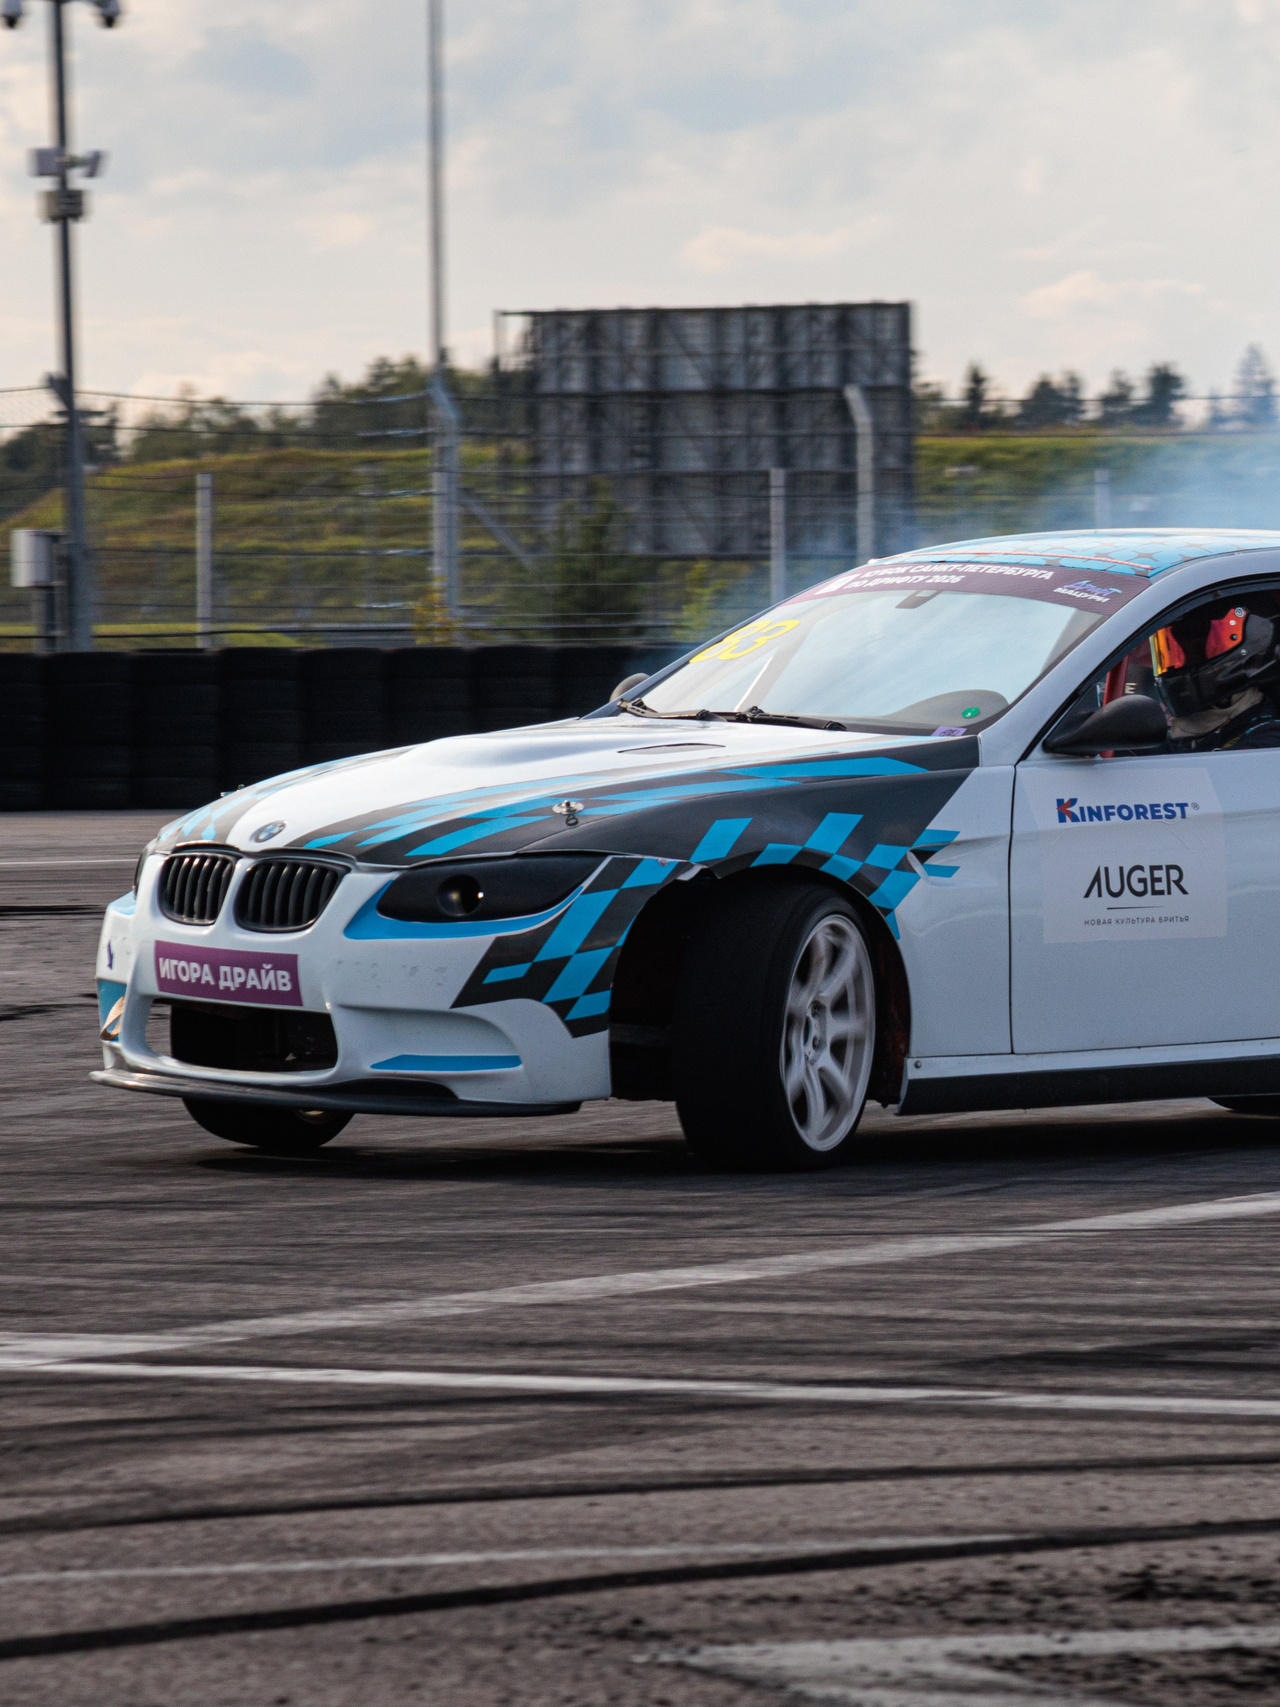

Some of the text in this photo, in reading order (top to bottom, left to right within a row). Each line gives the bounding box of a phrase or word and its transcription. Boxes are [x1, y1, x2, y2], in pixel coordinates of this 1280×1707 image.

[860, 564, 1054, 580] КУБОК САНКТ-ПЕТЕРБУРГА
[843, 580, 869, 590] ПО
[864, 575, 928, 588] ДРИФТУ
[1053, 587, 1110, 603] МАЦУРИ
[689, 619, 800, 663] 83
[1083, 864, 1189, 898] AUGER
[1084, 915, 1190, 926] НОВАЯ КУЛЬТУРА БРИТЬЯ
[158, 957, 293, 992] ИГОРА ДРАЙВ
